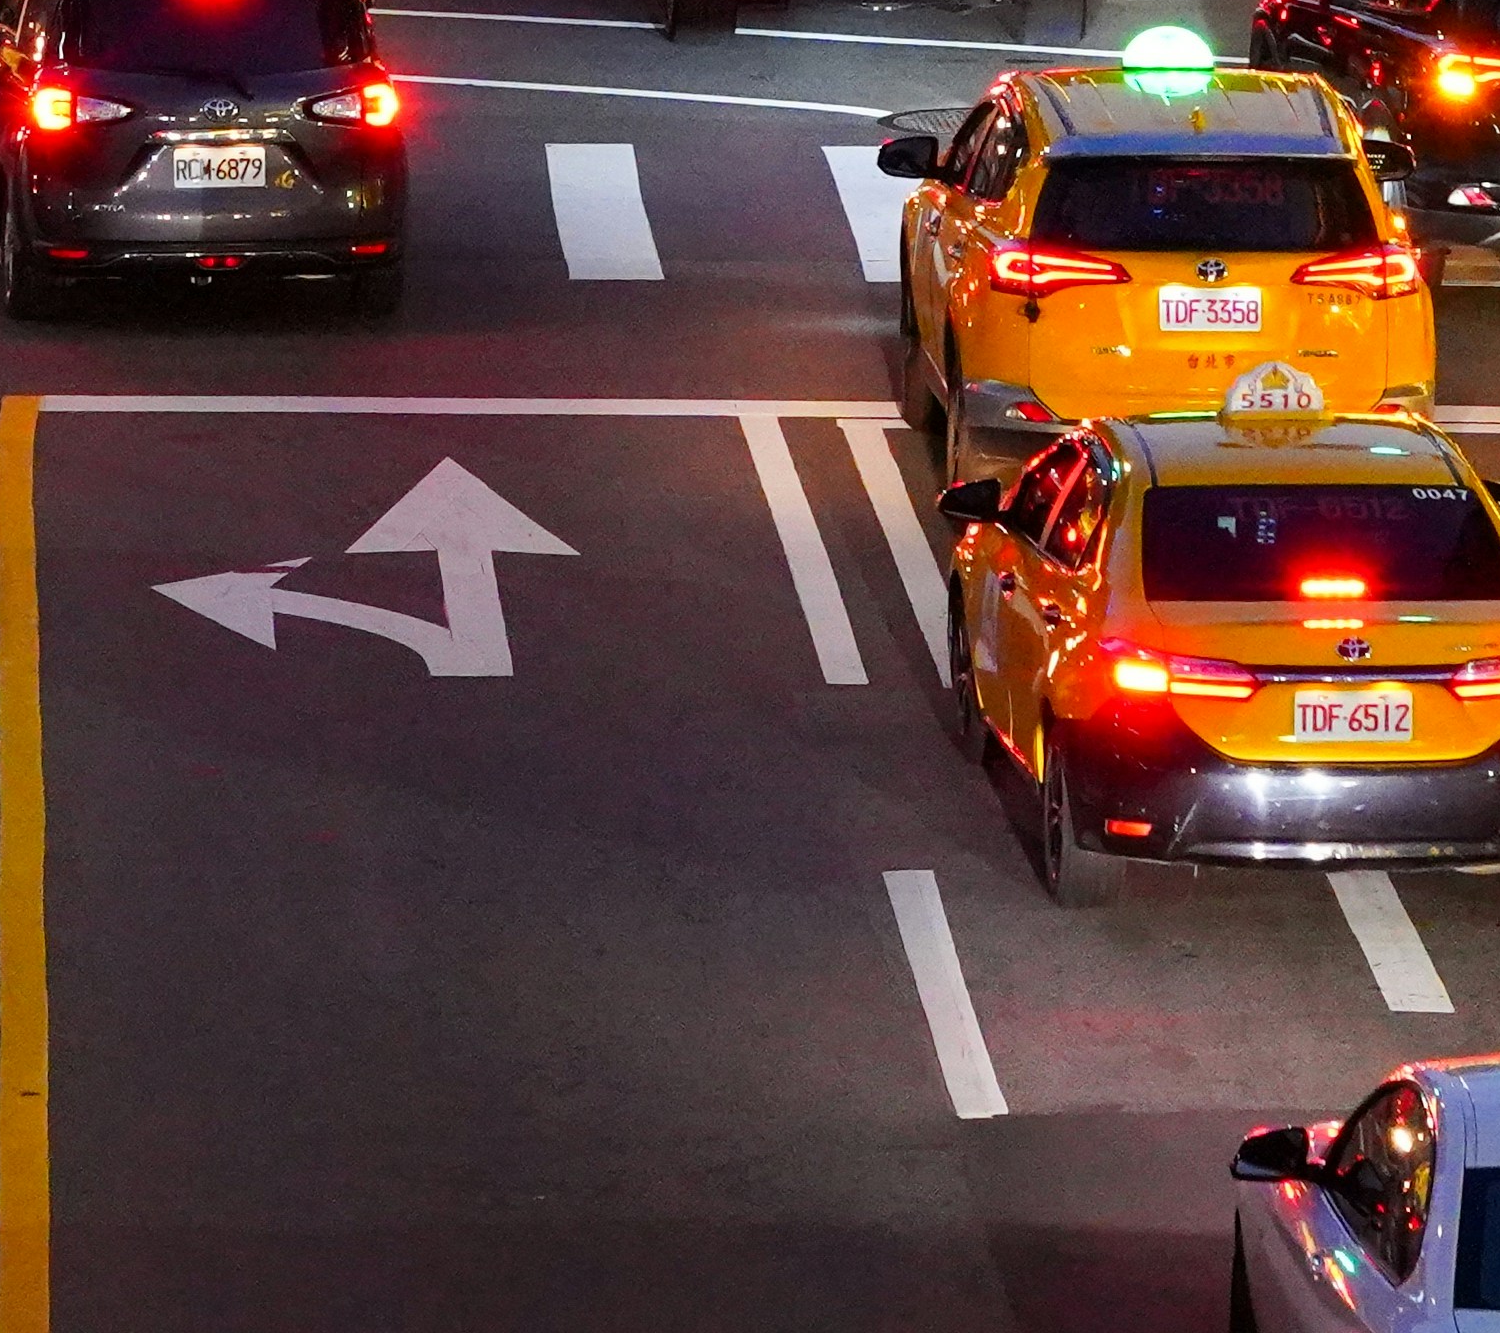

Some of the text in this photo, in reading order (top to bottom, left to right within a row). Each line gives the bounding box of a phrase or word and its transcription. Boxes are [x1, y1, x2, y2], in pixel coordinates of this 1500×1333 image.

[1187, 353, 1236, 370] 台北市
[1241, 390, 1312, 411] 5510
[1412, 487, 1469, 502] 0047
